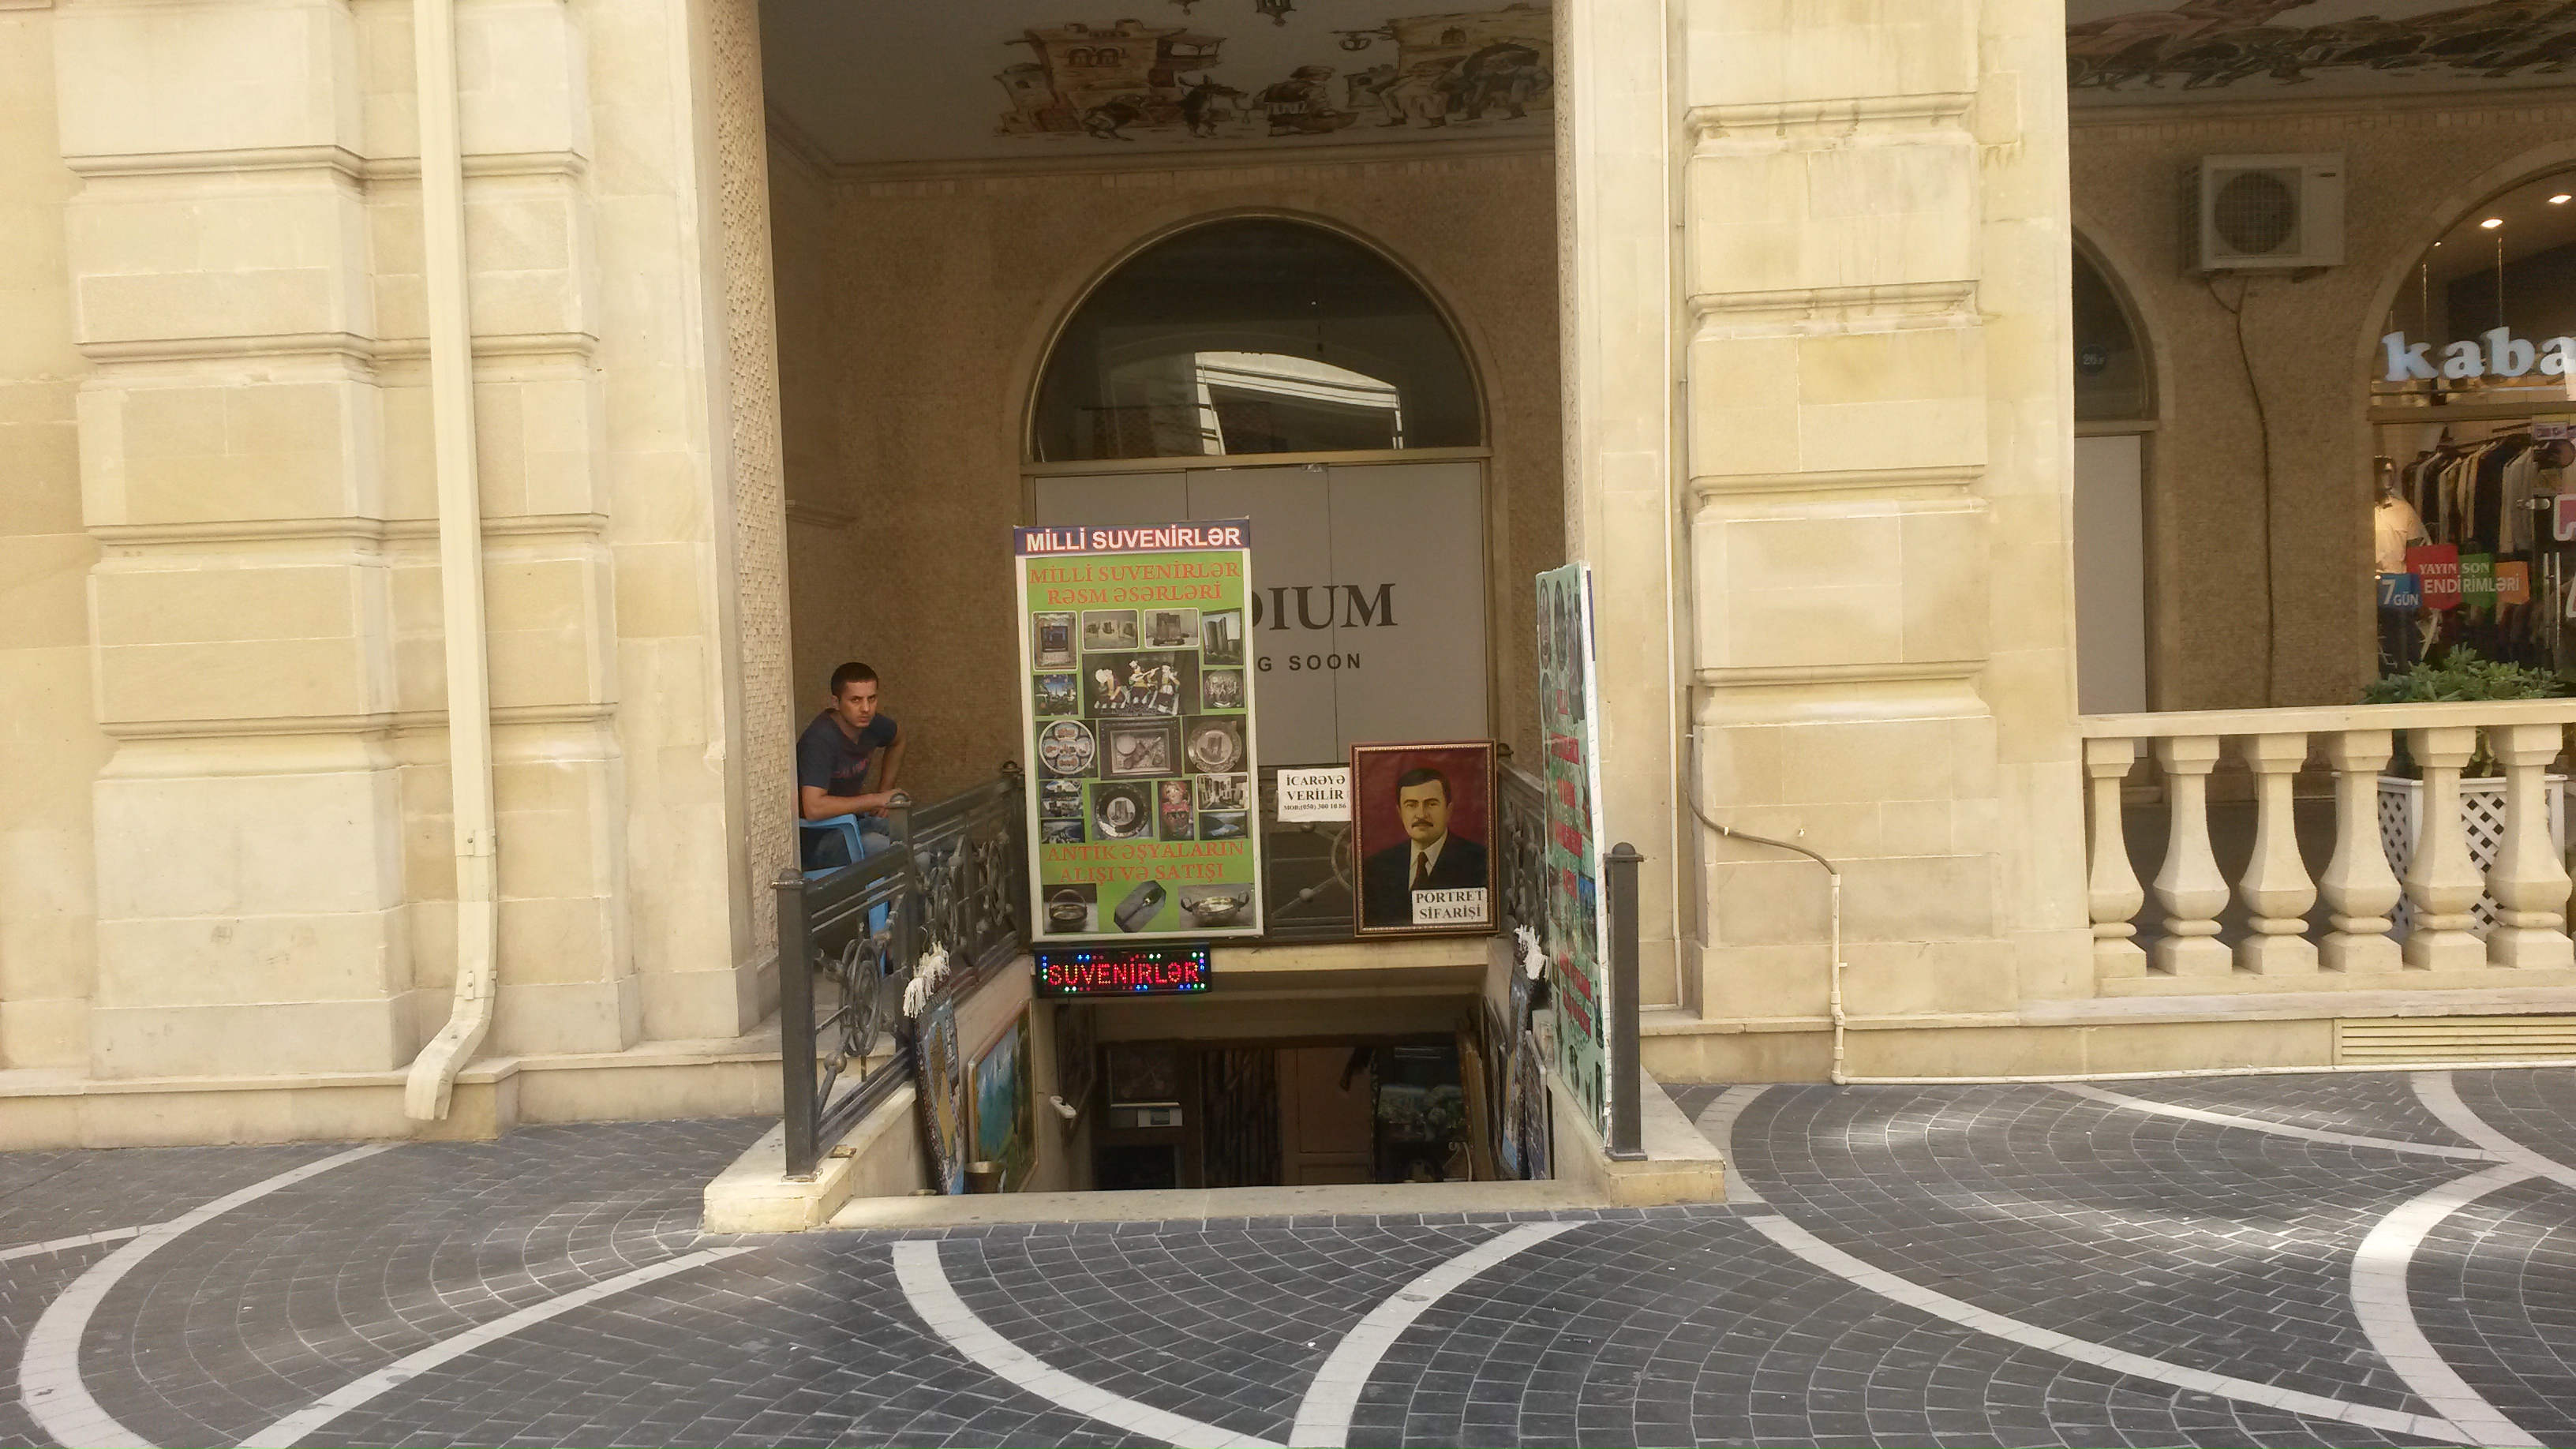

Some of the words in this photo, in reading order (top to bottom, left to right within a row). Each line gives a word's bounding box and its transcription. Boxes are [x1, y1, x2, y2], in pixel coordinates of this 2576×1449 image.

[1026, 527, 1086, 552] MİLLİ
[1092, 524, 1241, 549] SUVENİRLƏR
[1029, 564, 1092, 584] MİLLİ
[1099, 560, 1241, 582] SUVENİRLƏR
[2419, 563, 2457, 575] YAYIN
[2462, 561, 2490, 574] SON
[1047, 588, 1107, 605] RƏSM
[1114, 581, 1222, 603] ƏSƏRLƏRİ
[2382, 578, 2396, 605] 7
[2393, 591, 2419, 606] GÜN
[2424, 573, 2519, 593] ENDİRİMLƏRİ
[1252, 583, 1398, 631] IUM
[1288, 653, 1361, 672] SOON
[1286, 774, 1346, 786] İCARƏYƏ
[1286, 788, 1344, 801] VERİLİR
[1121, 841, 1245, 864] ƏŞYALARIN
[1058, 867, 1116, 886] ALIŞI
[1119, 866, 1149, 881] VƏ
[1154, 863, 1226, 883] SATIŞI
[1416, 889, 1485, 904] PORTRET
[1419, 904, 1481, 920] SİFARİŞİ
